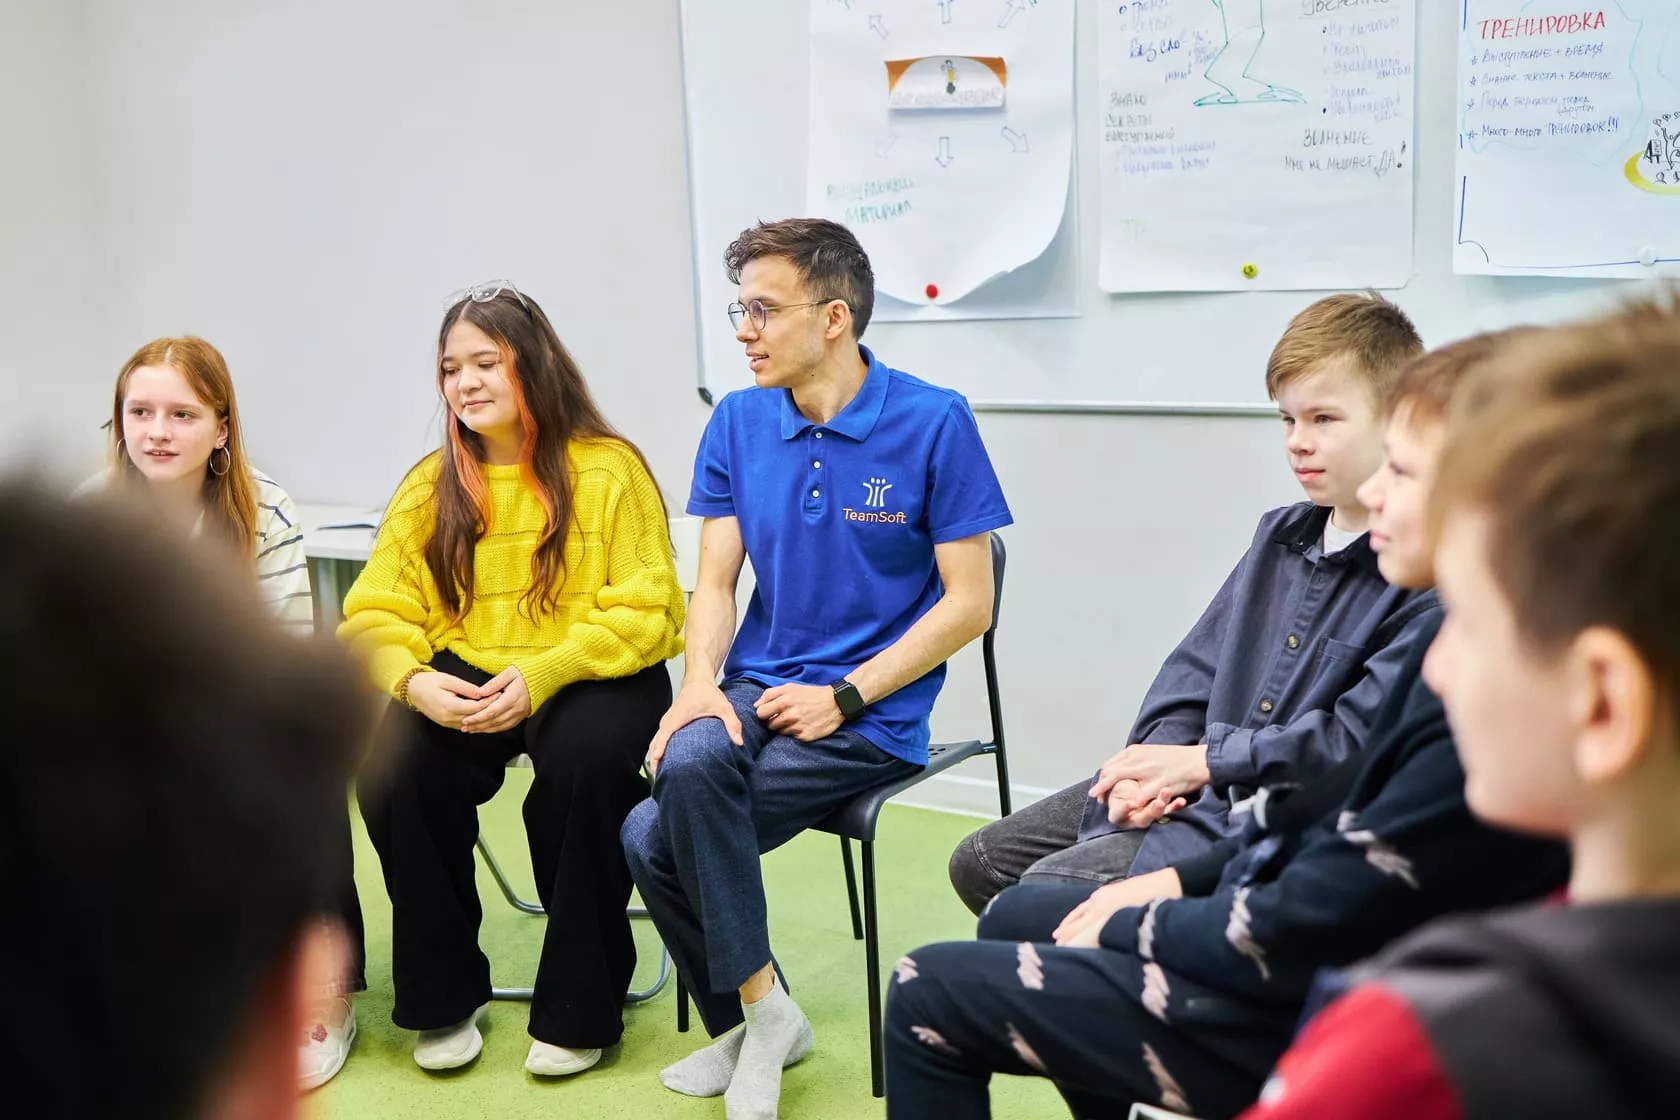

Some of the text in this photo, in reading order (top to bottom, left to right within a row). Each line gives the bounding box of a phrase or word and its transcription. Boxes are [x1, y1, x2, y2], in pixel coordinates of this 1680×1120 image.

[1477, 11, 1606, 40] ТРЕНИРОВКА
[1565, 42, 1604, 59] ВРЕМЯ
[842, 507, 907, 524] TeamSoft
